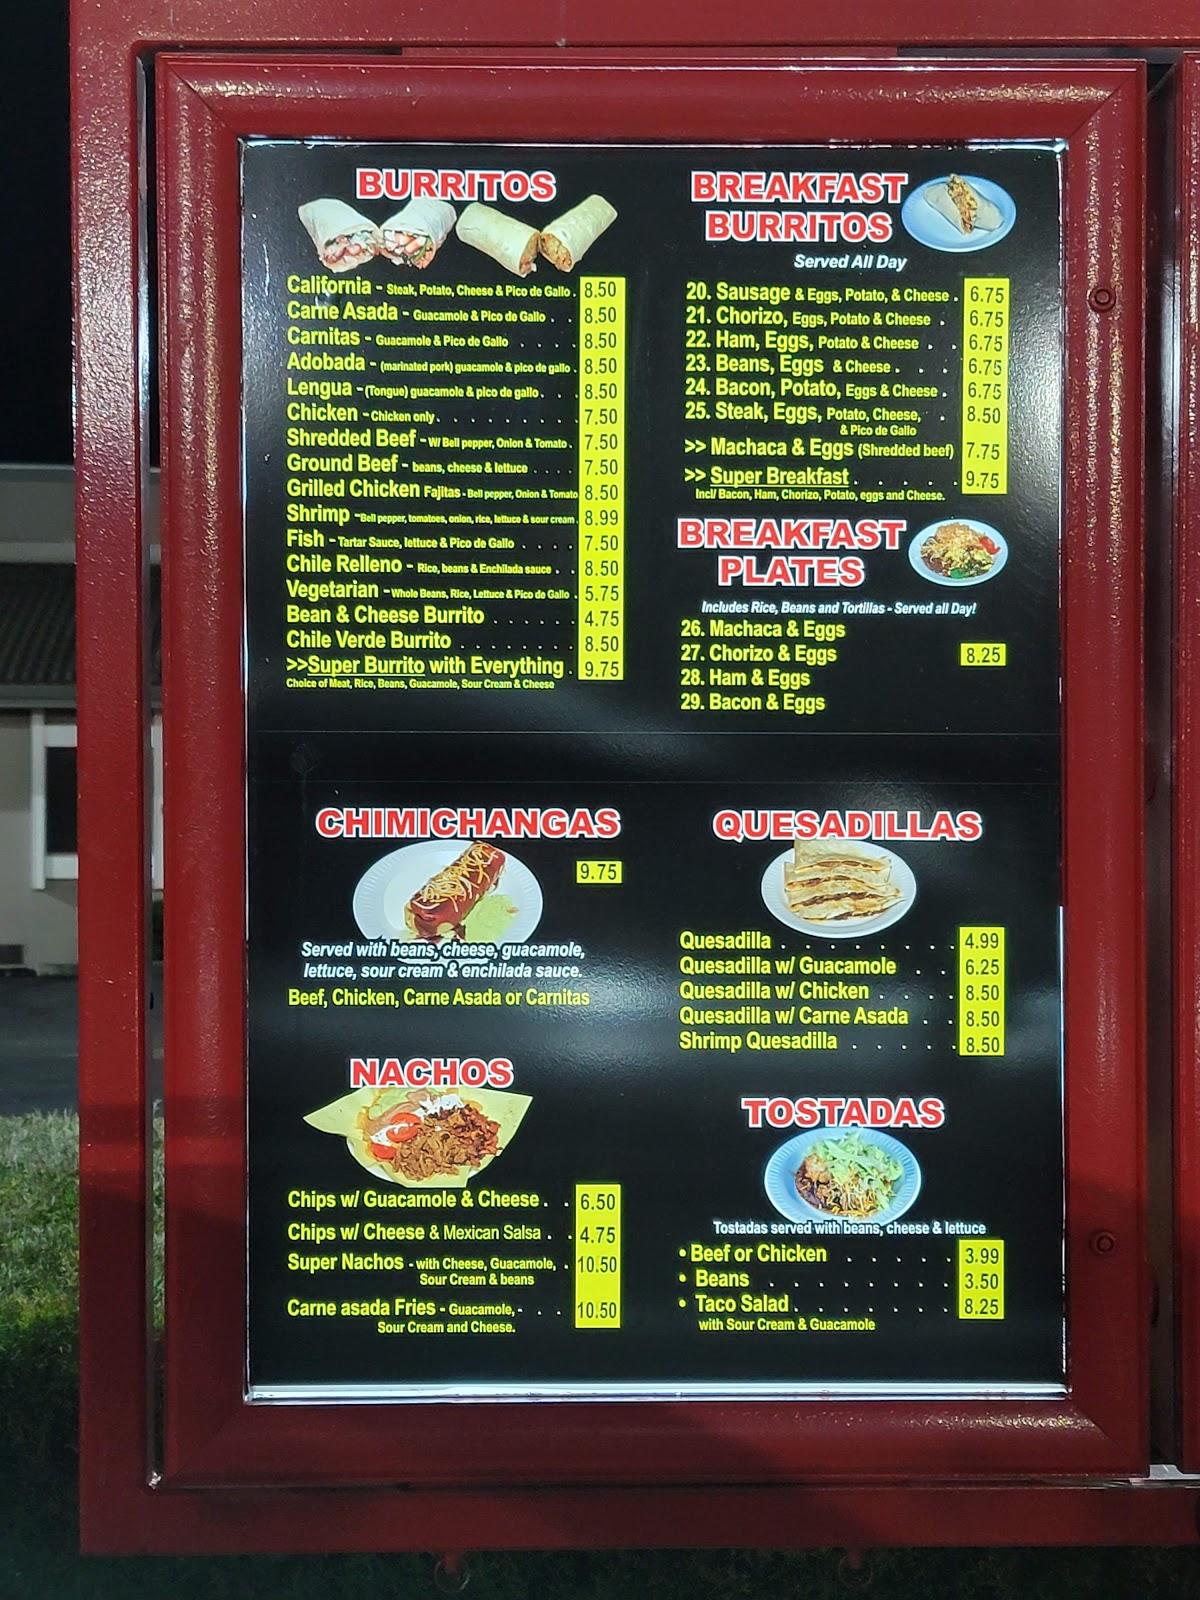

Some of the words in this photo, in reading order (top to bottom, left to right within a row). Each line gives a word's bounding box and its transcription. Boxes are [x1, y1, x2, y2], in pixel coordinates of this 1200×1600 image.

[356, 168, 556, 202] BURRITOS
[691, 171, 907, 203] BREAKFAST
[705, 210, 892, 243] BURRITOS
[794, 254, 849, 268] Served
[851, 255, 874, 268] All
[876, 255, 907, 272] Day
[287, 275, 371, 295] California
[387, 283, 417, 296] Steak,
[419, 284, 454, 297] Potato,
[456, 284, 493, 296] Cheese
[495, 285, 503, 296] &
[505, 285, 528, 297] Pico
[529, 286, 542, 297] de
[544, 285, 571, 297] Gallo
[585, 281, 616, 298] 8.50
[686, 282, 711, 300] 20.
[716, 282, 791, 304] Sausage
[795, 288, 805, 301] &
[808, 288, 842, 304] Eggs,
[845, 288, 888, 303] Potato,
[891, 288, 901, 301] &
[904, 288, 949, 302] Cheese
[971, 286, 1004, 303] 6.75
[343, 301, 398, 320] Asada
[413, 309, 469, 323] Guacamole
[470, 310, 479, 321] &
[481, 310, 503, 322] Pico
[505, 311, 518, 322] de
[519, 311, 546, 322] Gallo
[584, 307, 616, 324] 8.50
[287, 326, 360, 345] Carnitas
[376, 334, 431, 346] Guacamole
[433, 335, 441, 346] &
[443, 335, 466, 346] Pico
[467, 336, 480, 347] de
[482, 335, 508, 347] Gallo
[585, 332, 616, 349] 8.50
[685, 378, 711, 395] 24.
[716, 378, 775, 399] Bacon,
[781, 378, 841, 399] Potato,
[846, 383, 877, 400] Eggs
[880, 384, 890, 397] &
[892, 384, 938, 397] Cheese
[968, 382, 1001, 400] 6.75
[287, 453, 353, 472] Ground
[358, 454, 399, 472] Beef
[412, 461, 445, 474] beans,
[447, 462, 483, 473] cheese
[484, 462, 493, 473] &
[494, 462, 528, 473] lettuce
[585, 459, 618, 475] 7.50
[718, 488, 752, 501] Bacon,
[754, 489, 779, 501] Ham,
[781, 489, 822, 501] Chorizo,
[824, 489, 858, 501] Potato,
[860, 491, 884, 502] eggs
[886, 490, 904, 500] and
[906, 490, 945, 500] Cheese.
[677, 518, 907, 550] BREAKFAST
[287, 554, 332, 572] Chile
[337, 554, 402, 573] Relleno
[417, 563, 440, 574] Rice,
[441, 563, 469, 573] beans
[470, 563, 478, 573] &
[479, 563, 523, 574] Enchilada
[525, 566, 552, 574] sauce
[585, 560, 618, 576] 8.50
[718, 555, 865, 587] PLATES
[287, 605, 331, 623] Bean
[336, 605, 350, 623] &
[354, 605, 419, 623] Cheese
[424, 605, 484, 624] Burrito
[585, 611, 619, 627] 4.75
[702, 601, 749, 613] Includes
[751, 601, 778, 615] Rice,
[781, 601, 816, 614] Beans
[818, 602, 840, 614] and
[842, 602, 885, 614] Tortillas
[894, 602, 934, 614] Served
[935, 602, 949, 614] all
[951, 602, 977, 617] Day!
[287, 630, 332, 648] Chile
[335, 630, 386, 648] Verde
[391, 631, 451, 648] Burrito
[585, 636, 619, 652] 8.50
[681, 619, 705, 636] 26.
[710, 619, 782, 637] Machaca
[786, 620, 799, 637] &
[804, 620, 845, 641] Eggs
[681, 644, 705, 661] 27.
[709, 644, 774, 661] Chorizo
[778, 644, 790, 661] &
[795, 644, 837, 666] Eggs
[967, 647, 1000, 663] 8.25
[681, 668, 705, 685] 28.
[710, 668, 746, 685] Ham
[751, 668, 764, 686] &
[768, 669, 810, 690] Eggs
[681, 693, 705, 710] 29.
[710, 693, 761, 710] Bacon
[766, 693, 779, 710] &
[784, 693, 825, 714] Eggs
[315, 807, 621, 838] CHIMICHANGAS
[713, 810, 983, 843] QUESADILLAS
[581, 863, 616, 880] 9.75
[301, 942, 354, 957] Served
[356, 942, 387, 957] with
[390, 942, 441, 959] beans,
[443, 941, 498, 959] cheese,
[501, 942, 585, 960] guacamole,
[680, 931, 771, 950] Quesadilla
[965, 933, 999, 949] 4.99
[680, 956, 771, 975] Quesadilla
[775, 956, 795, 974] w/
[799, 956, 896, 974] Guacamole
[966, 959, 999, 975] 6.25
[289, 988, 327, 1008] Beef,
[332, 988, 399, 1008] Chicken,
[404, 988, 449, 1005] Carne
[453, 988, 502, 1005] Asada
[505, 992, 522, 1005] or
[526, 988, 590, 1005] Carnitas
[680, 981, 771, 1000] Quesadilla
[775, 981, 795, 999] w/
[799, 981, 869, 999] Chicken
[966, 985, 999, 1001] 8.50
[350, 1058, 514, 1089] NACHOS
[741, 1097, 945, 1128] TOSTADAS
[288, 1190, 336, 1211] Chips
[340, 1190, 360, 1207] w/
[364, 1190, 456, 1207] Guacamole
[461, 1190, 474, 1207] &
[478, 1190, 539, 1207] Cheese
[581, 1193, 615, 1210] 6.50
[713, 1221, 768, 1234] Tostadas
[771, 1221, 812, 1234] served
[814, 1221, 842, 1234] with
[844, 1221, 883, 1236] beans,
[886, 1221, 930, 1234] cheese
[932, 1221, 942, 1234] &
[945, 1221, 986, 1234] lettuce
[691, 1244, 731, 1262] Beef
[734, 1248, 753, 1262] or
[757, 1244, 827, 1262] Chicken
[965, 1248, 999, 1264] 3.99
[378, 1321, 405, 1333] Sour
[407, 1321, 444, 1333] Cream
[447, 1321, 468, 1333] and
[471, 1321, 516, 1333] Cheese.
